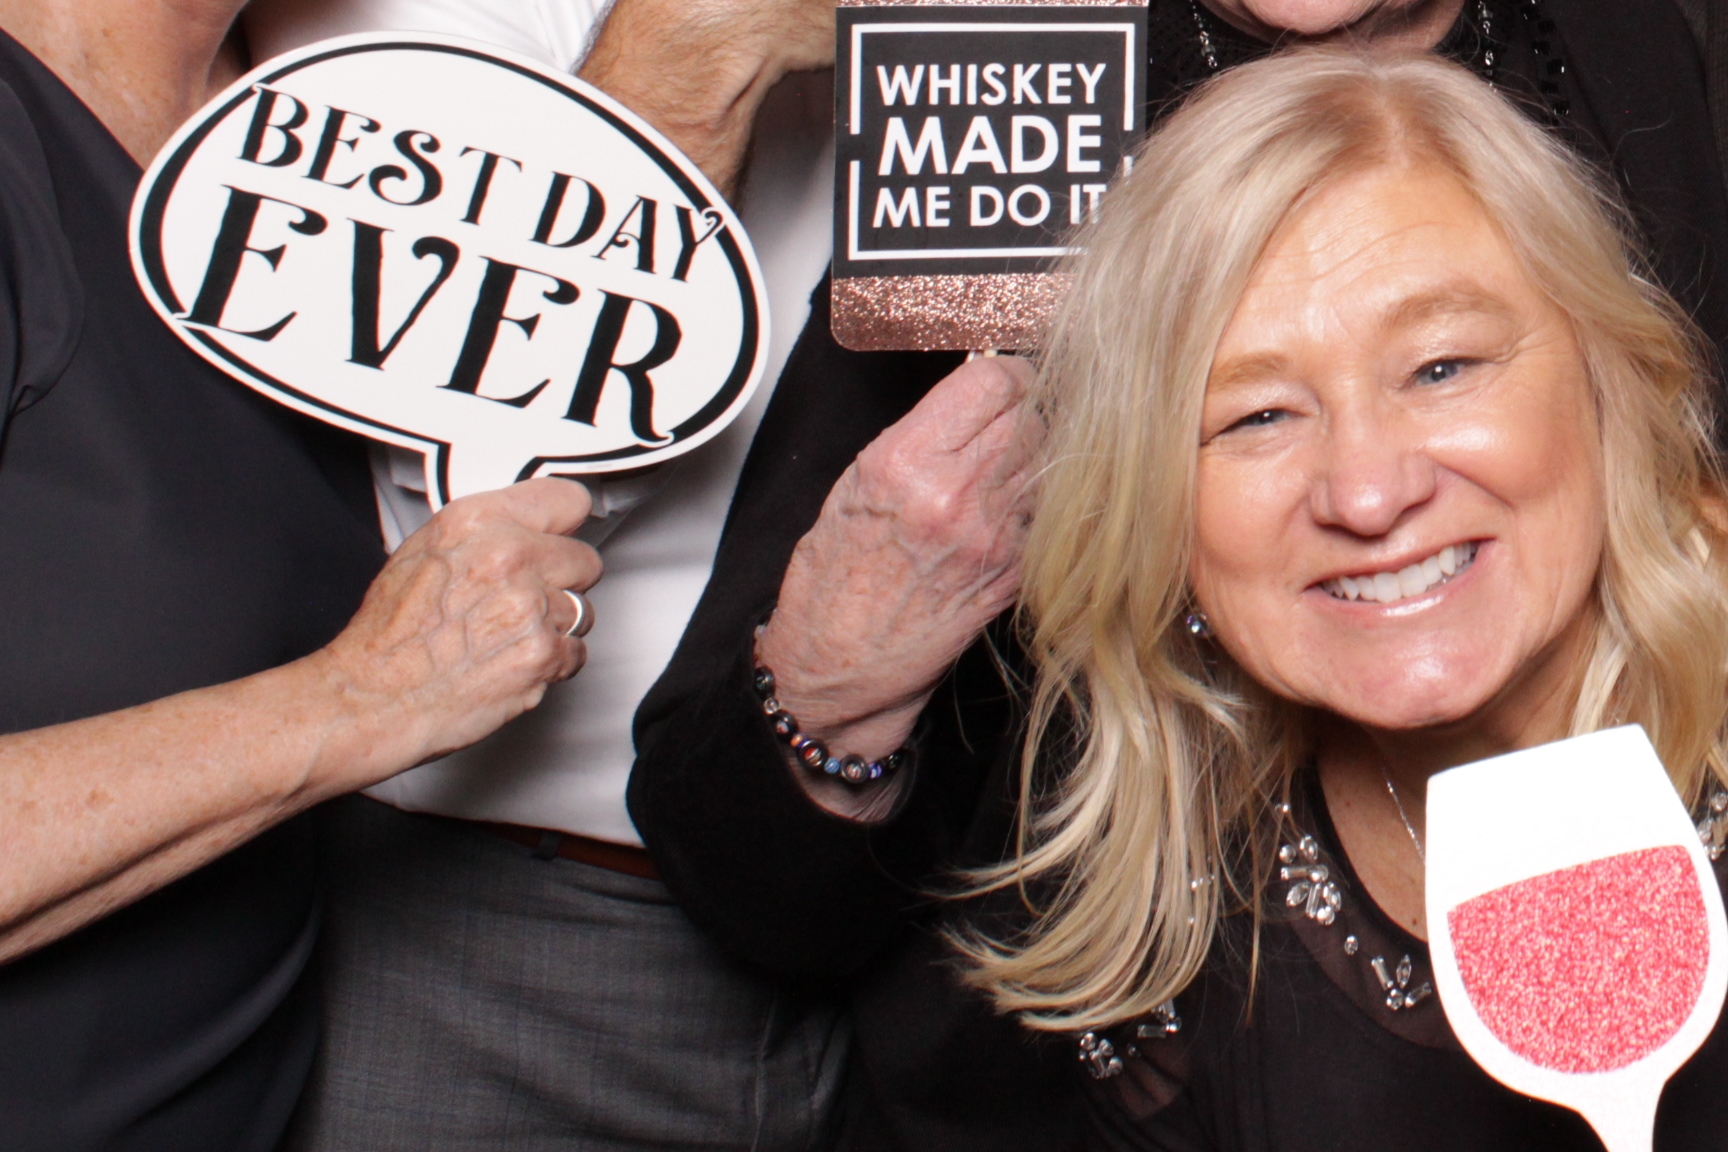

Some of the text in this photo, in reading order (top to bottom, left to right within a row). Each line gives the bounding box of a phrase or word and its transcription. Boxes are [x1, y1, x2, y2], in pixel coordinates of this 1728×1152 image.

[876, 62, 1107, 106] WHISKEY
[877, 114, 1102, 176] MADE
[235, 84, 723, 283] BEST DAY
[872, 184, 1107, 228] ME DO IT
[178, 183, 683, 445] EVER
